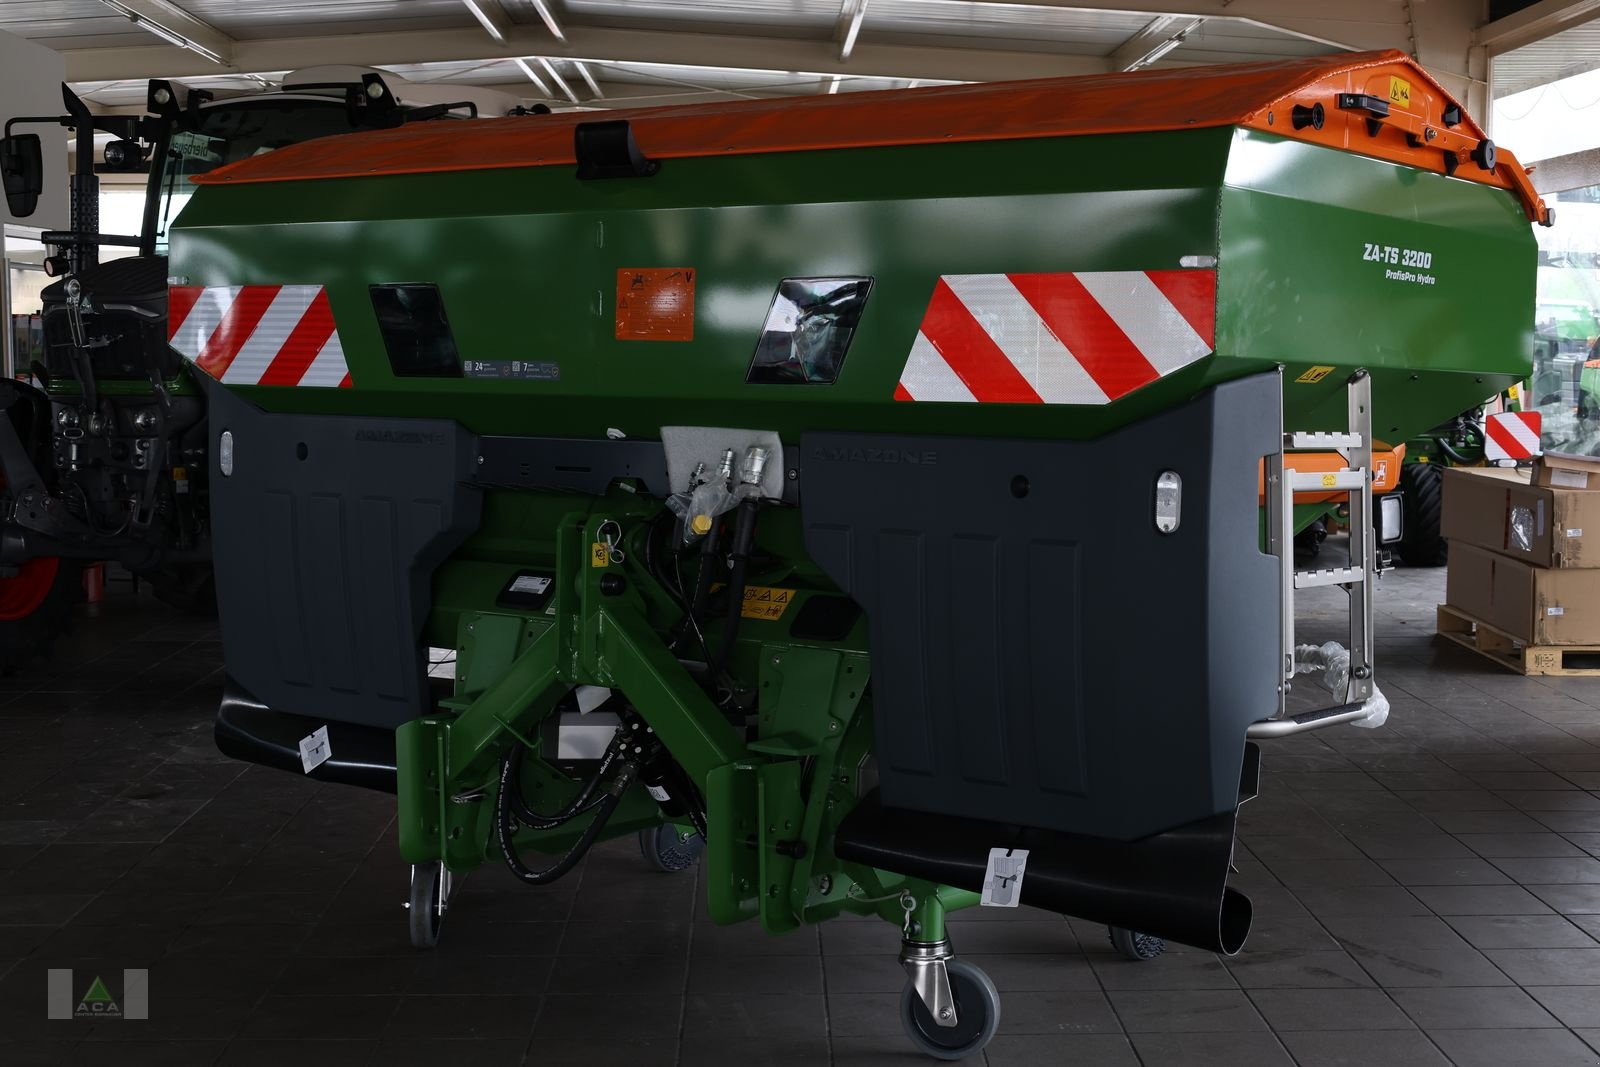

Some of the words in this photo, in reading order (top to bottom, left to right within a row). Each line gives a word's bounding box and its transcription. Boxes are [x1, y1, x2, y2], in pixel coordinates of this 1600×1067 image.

[1363, 243, 1399, 264] ZA-TS
[1402, 249, 1432, 269] 3200
[1385, 269, 1416, 282] ProfisPro
[1416, 273, 1436, 286] Hydro
[475, 362, 483, 371] 24
[523, 363, 528, 372] 7
[810, 447, 937, 465] AMAZONE
